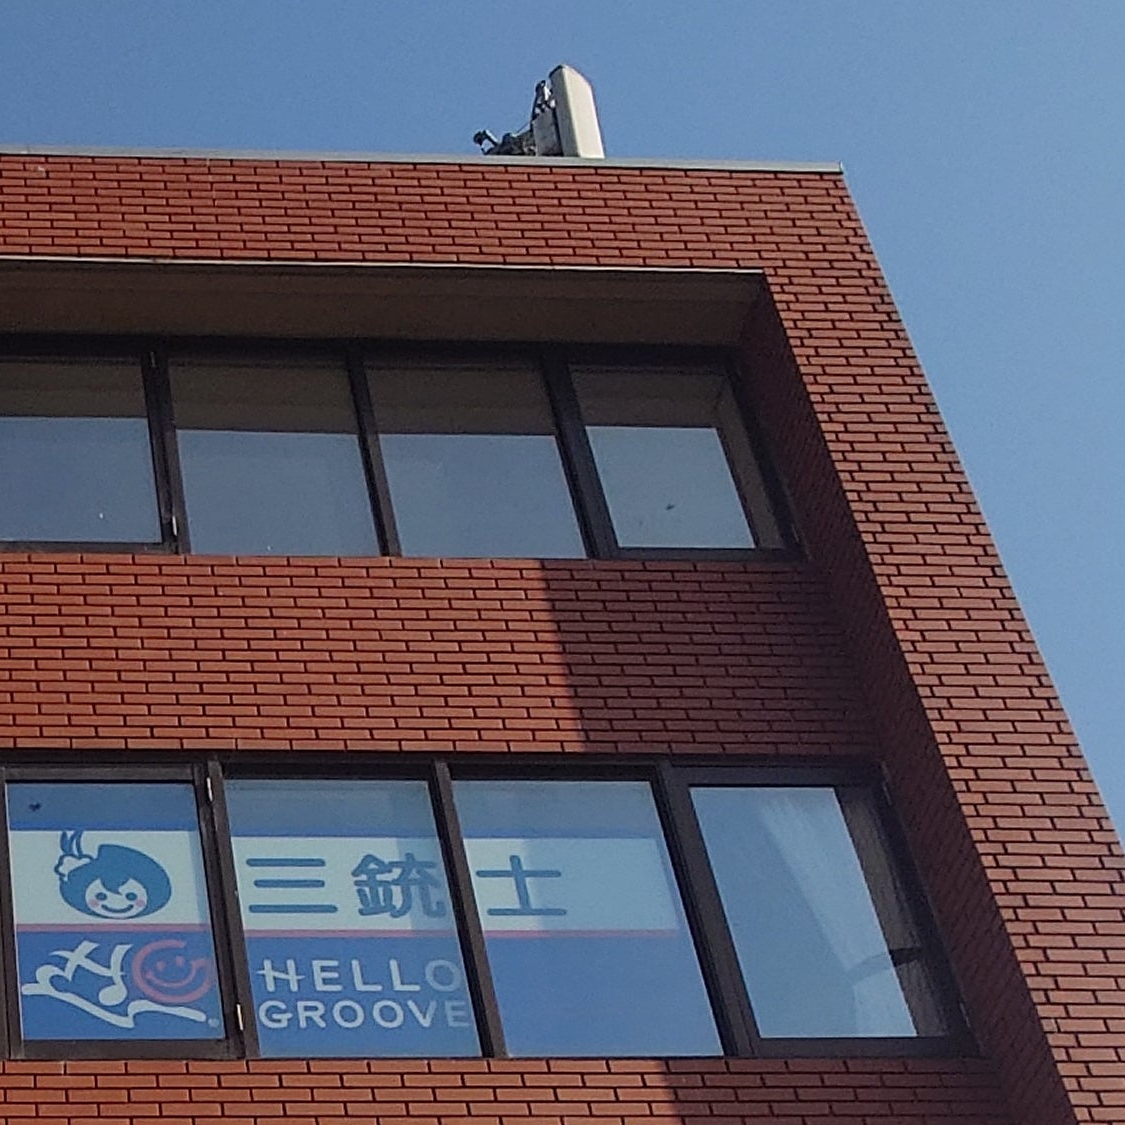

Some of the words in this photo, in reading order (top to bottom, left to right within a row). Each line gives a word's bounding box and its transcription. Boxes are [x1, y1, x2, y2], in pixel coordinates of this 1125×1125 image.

[244, 851, 569, 920] 三銃士
[256, 958, 463, 993] HELLO
[258, 999, 475, 1029] GROOVE
